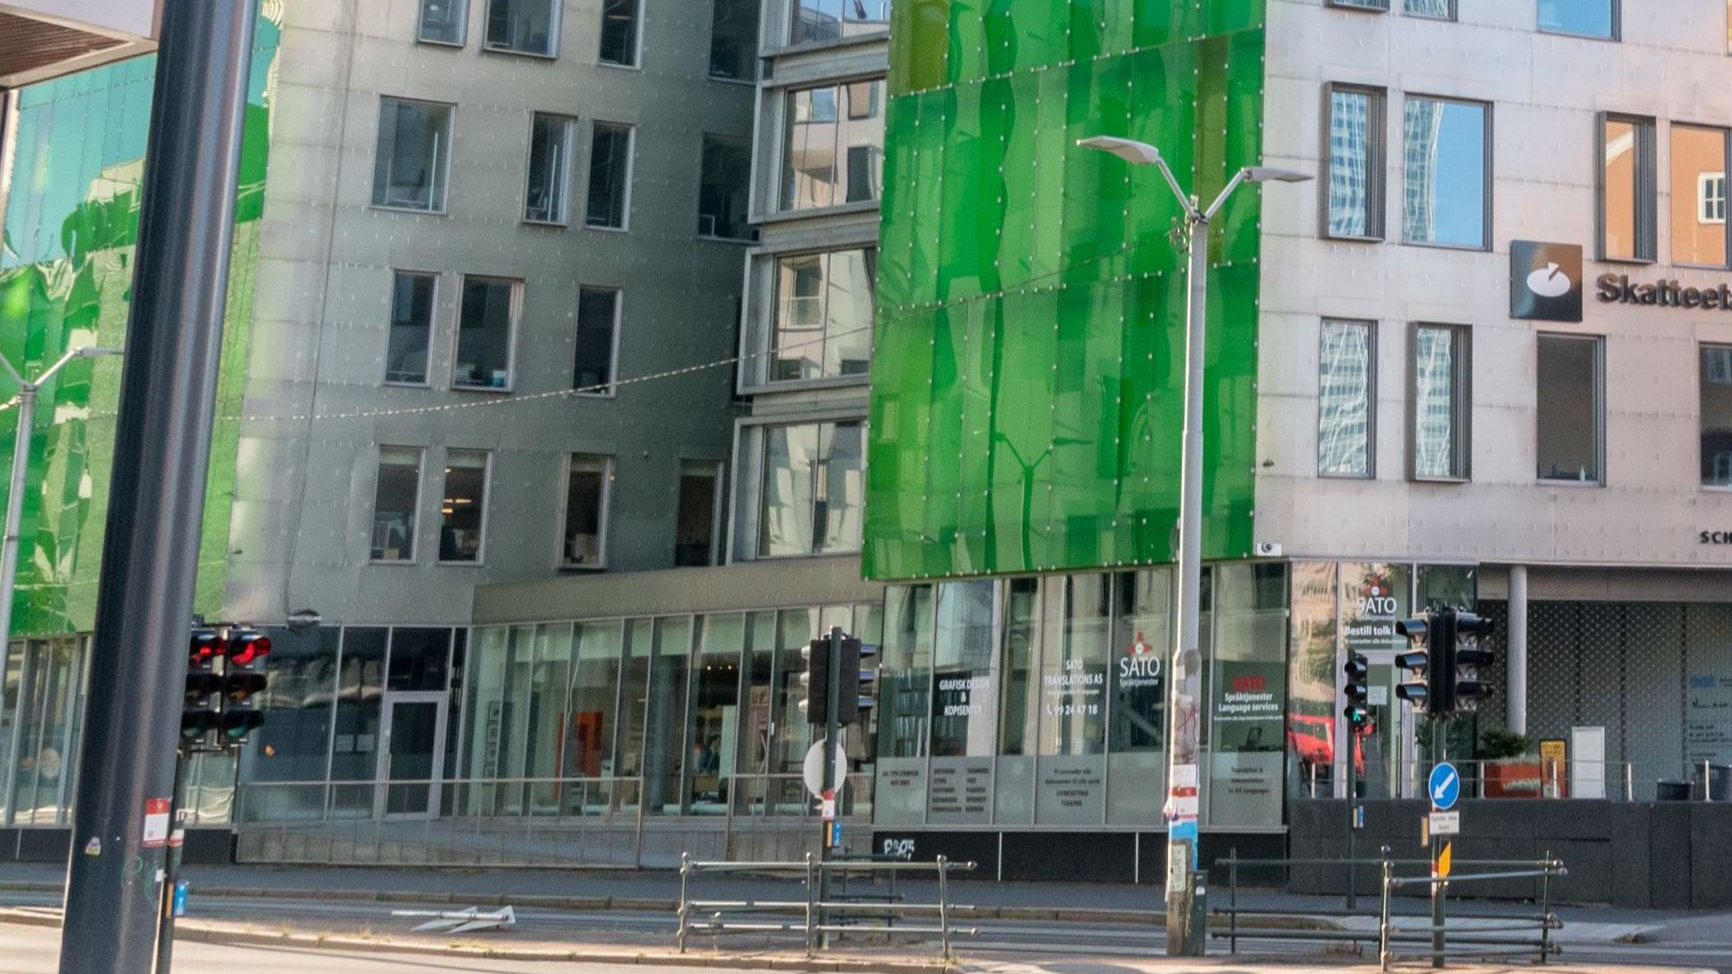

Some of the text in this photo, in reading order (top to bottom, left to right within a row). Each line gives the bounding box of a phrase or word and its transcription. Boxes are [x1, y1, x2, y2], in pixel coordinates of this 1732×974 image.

[1356, 596, 1397, 614] SATO
[1344, 625, 1391, 635] Bestill tolk
[1066, 659, 1083, 670] SATO
[1120, 657, 1160, 677] SATO
[939, 679, 966, 690] GRAFISK
[1044, 673, 1103, 686] TRANSLATIONS AS
[944, 705, 982, 716] KOPISENTER
[1219, 703, 1251, 714] Language
